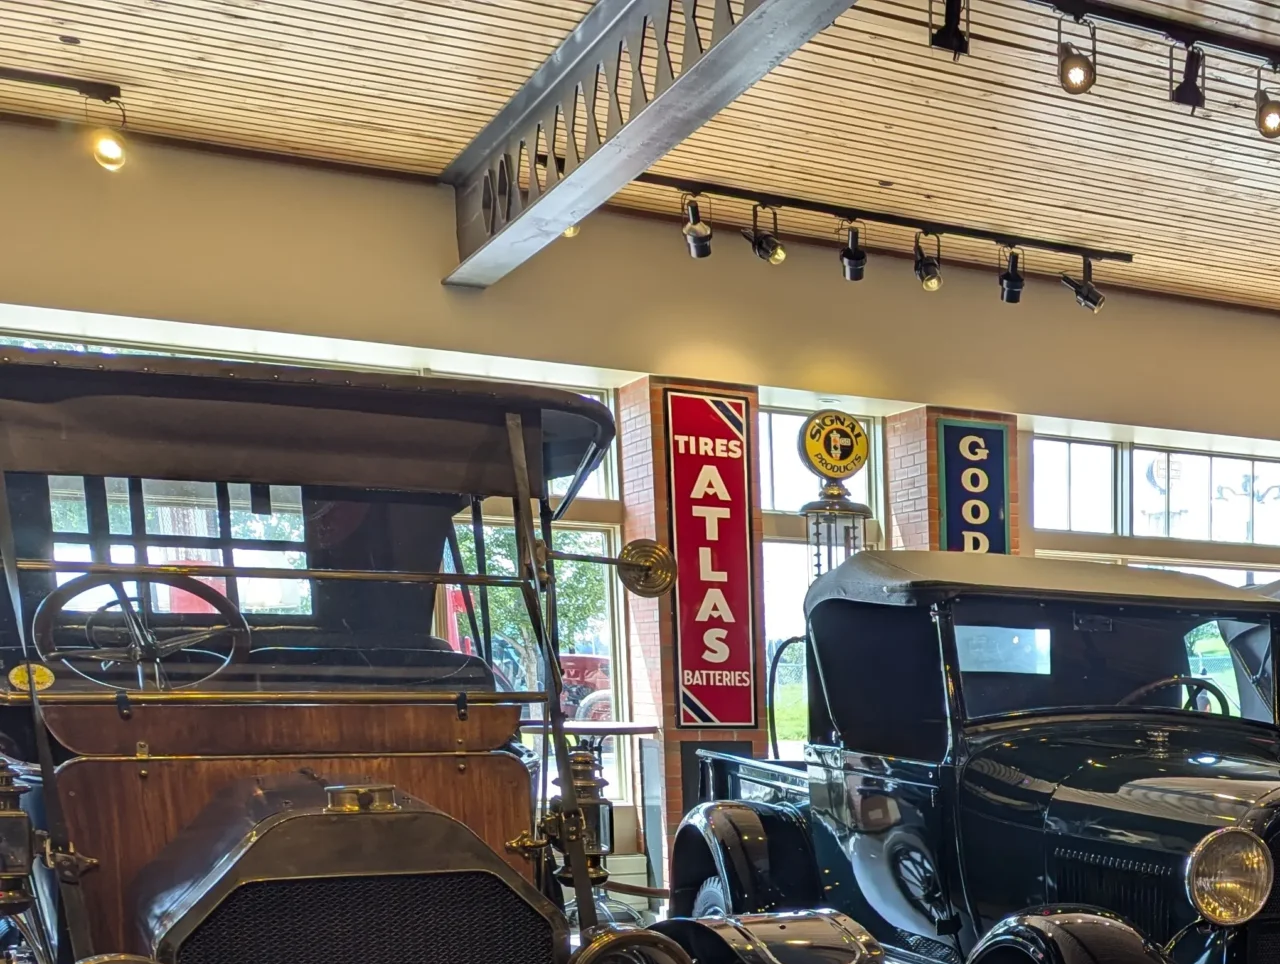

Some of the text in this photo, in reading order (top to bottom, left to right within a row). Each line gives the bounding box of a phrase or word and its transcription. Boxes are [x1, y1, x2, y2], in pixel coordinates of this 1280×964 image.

[809, 415, 863, 446] SIGNAL
[674, 434, 742, 459] TIRES
[813, 453, 862, 473] PRODUCTS
[959, 435, 990, 554] GOOD
[690, 464, 736, 664] ATLAS
[683, 670, 750, 687] BATTERIES
